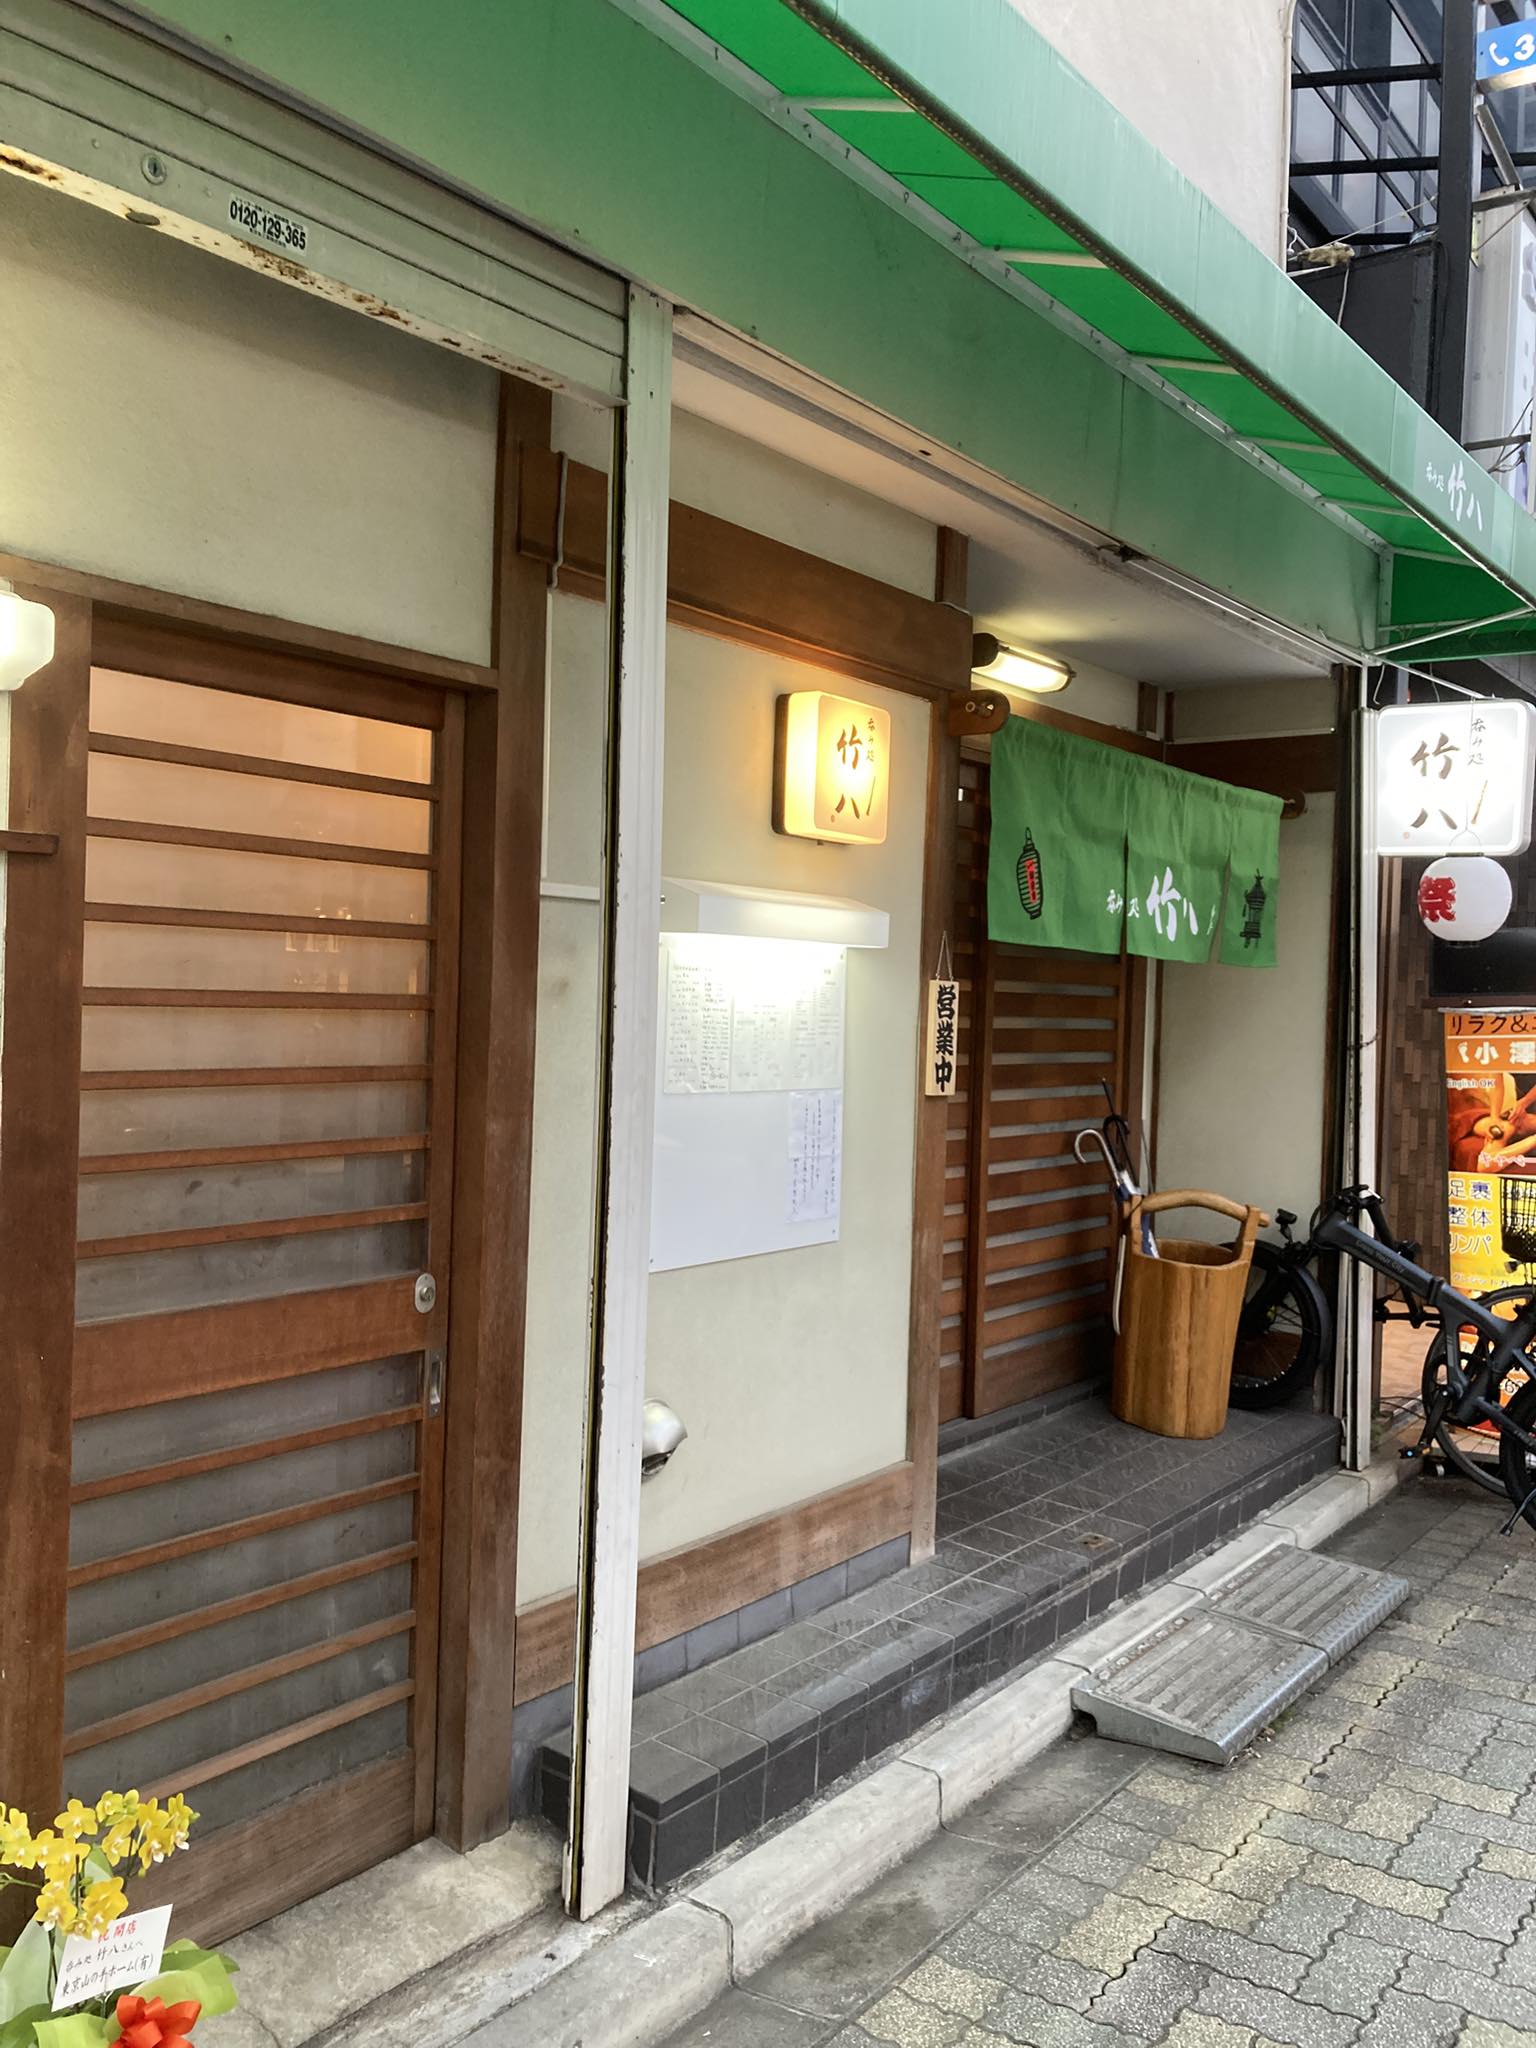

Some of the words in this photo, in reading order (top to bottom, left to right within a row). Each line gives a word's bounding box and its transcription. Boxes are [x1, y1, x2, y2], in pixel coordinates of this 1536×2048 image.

[230, 201, 306, 250] 0120-129-365
[1447, 459, 1482, 532] 竹八
[835, 724, 863, 820] 竹八
[1410, 731, 1461, 831] 竹八
[934, 984, 957, 1093] 営業中
[1479, 1078, 1496, 1089] OK
[1449, 1179, 1491, 1201] 足裏
[1449, 1207, 1492, 1228] 整体
[1449, 1233, 1492, 1256] リンパ
